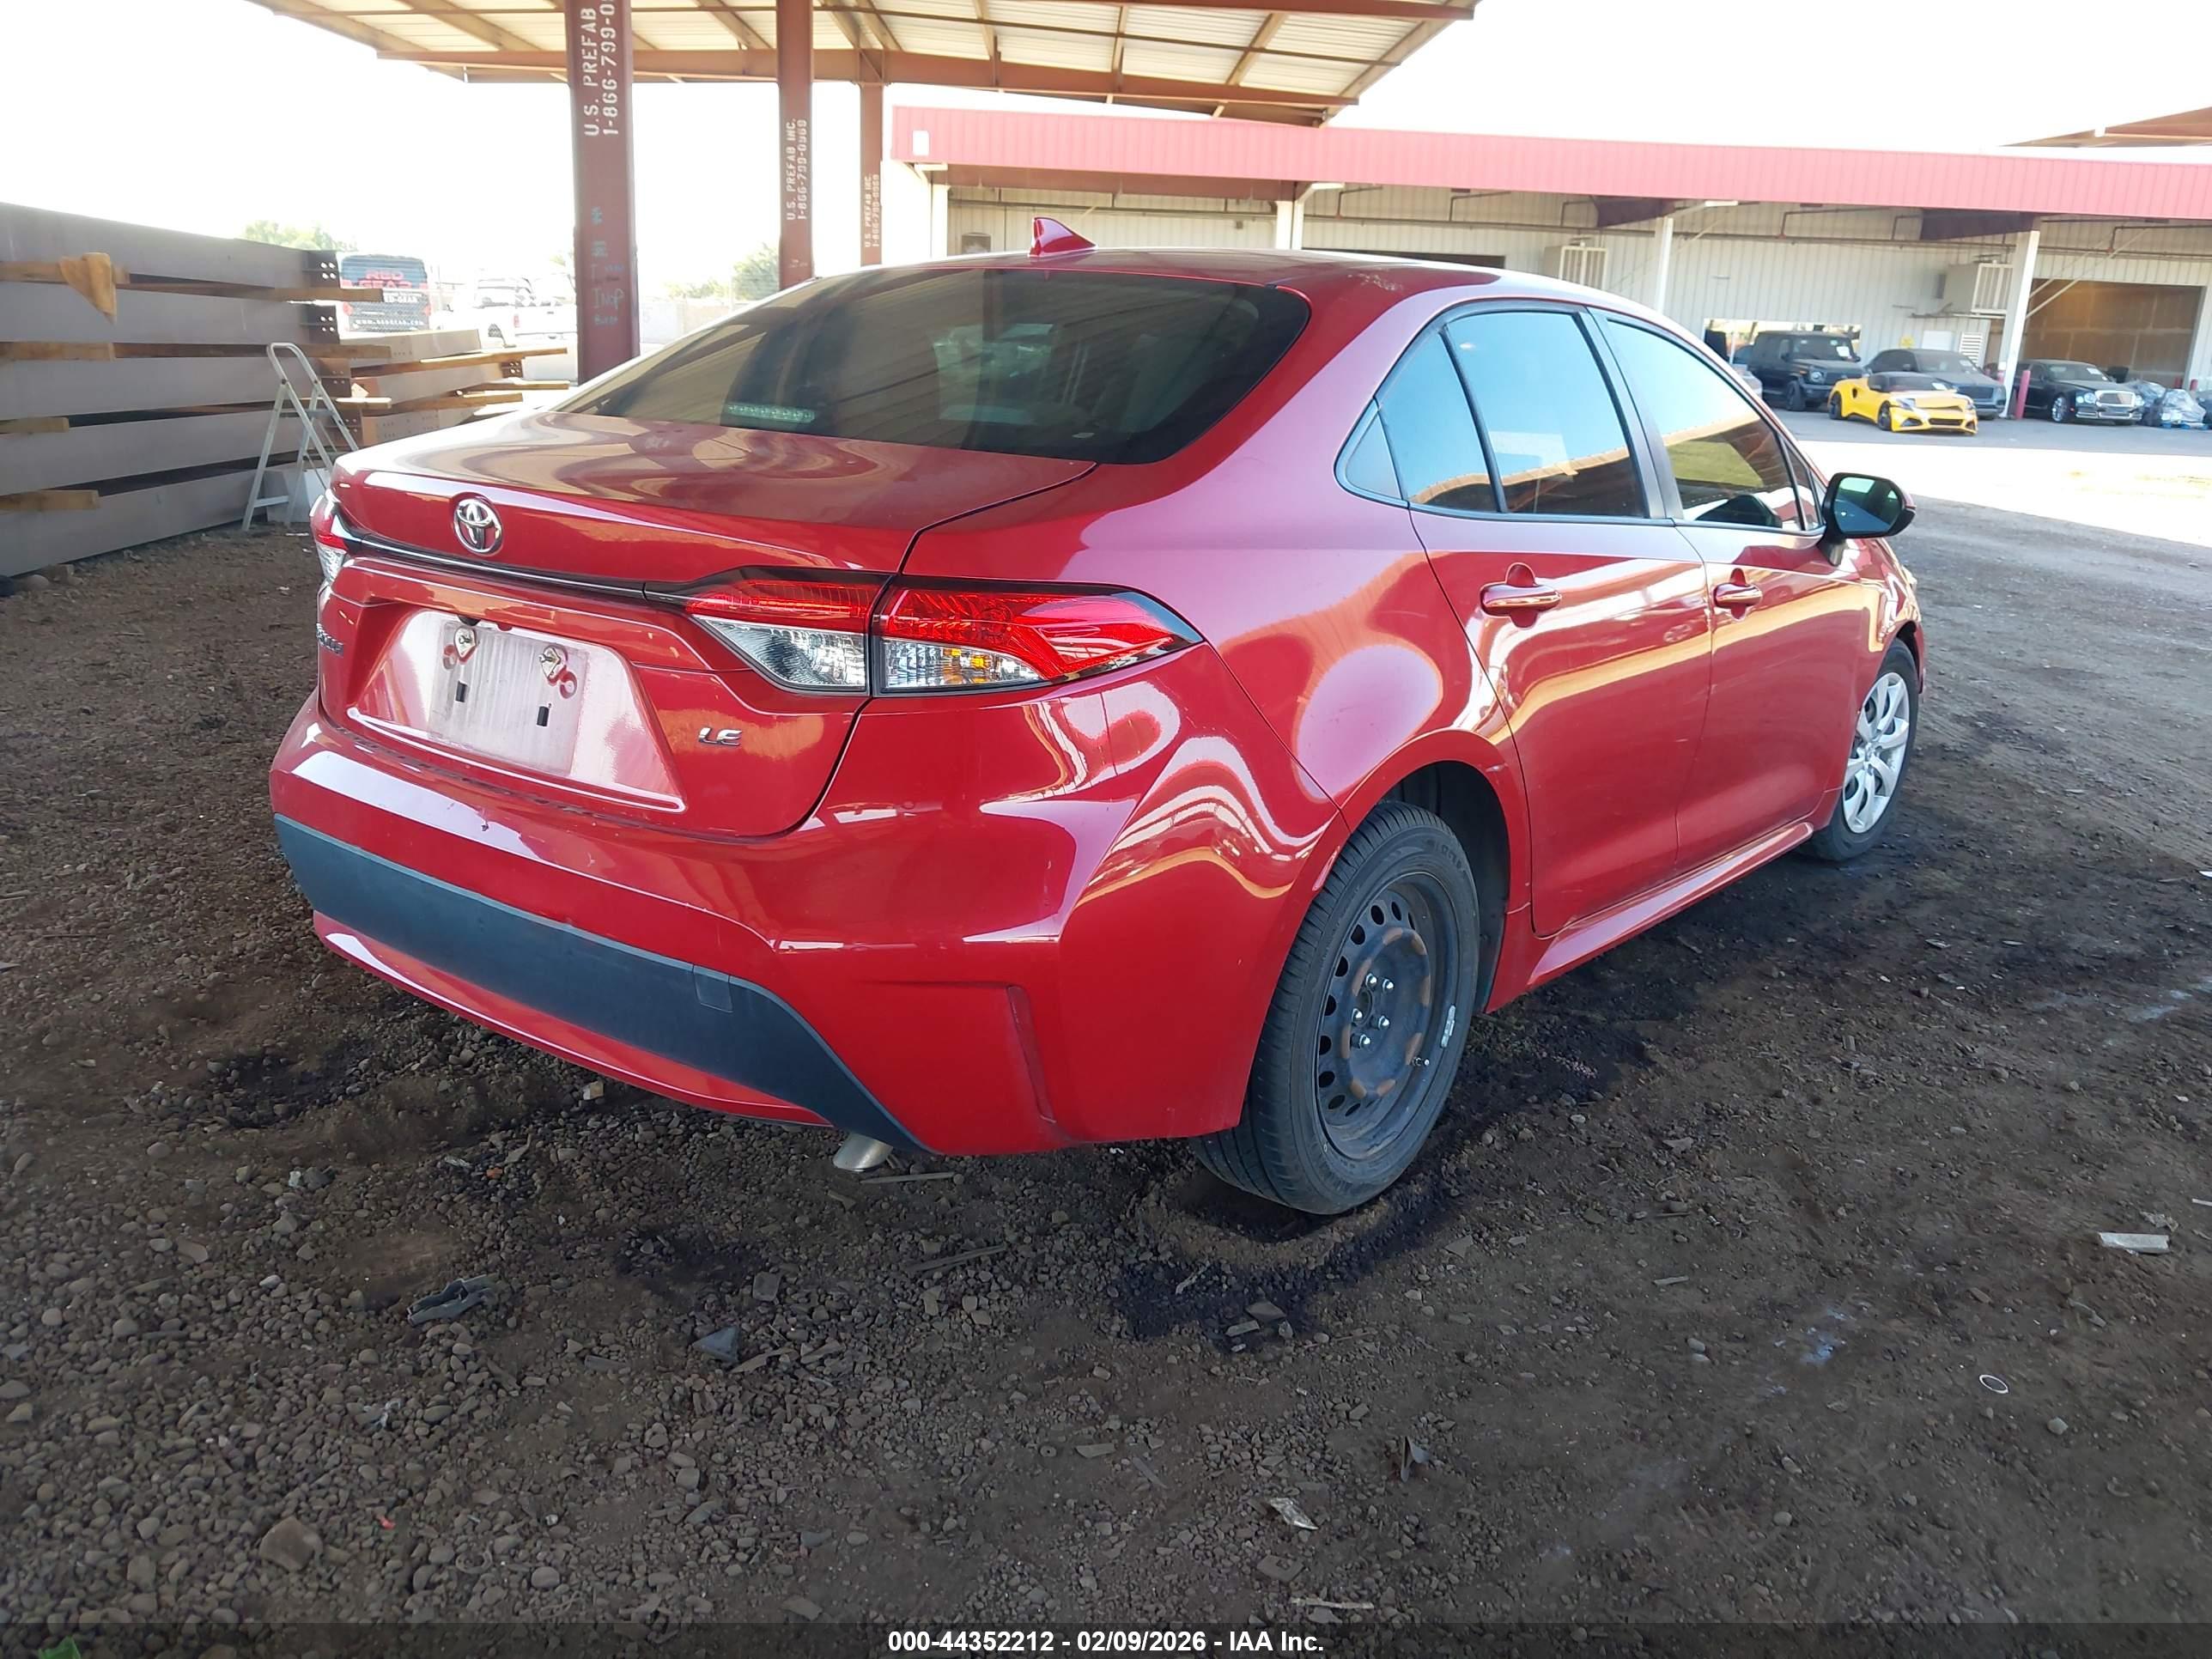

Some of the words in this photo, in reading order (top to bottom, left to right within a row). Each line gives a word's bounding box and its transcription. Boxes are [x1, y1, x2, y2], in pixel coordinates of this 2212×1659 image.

[580, 8, 599, 87] PREFAB
[599, 0, 619, 135] 1-866-799-0
[584, 99, 599, 136] U.S.
[786, 118, 797, 142] INC.
[786, 146, 796, 192] PREFAB
[698, 727, 743, 746] LE
